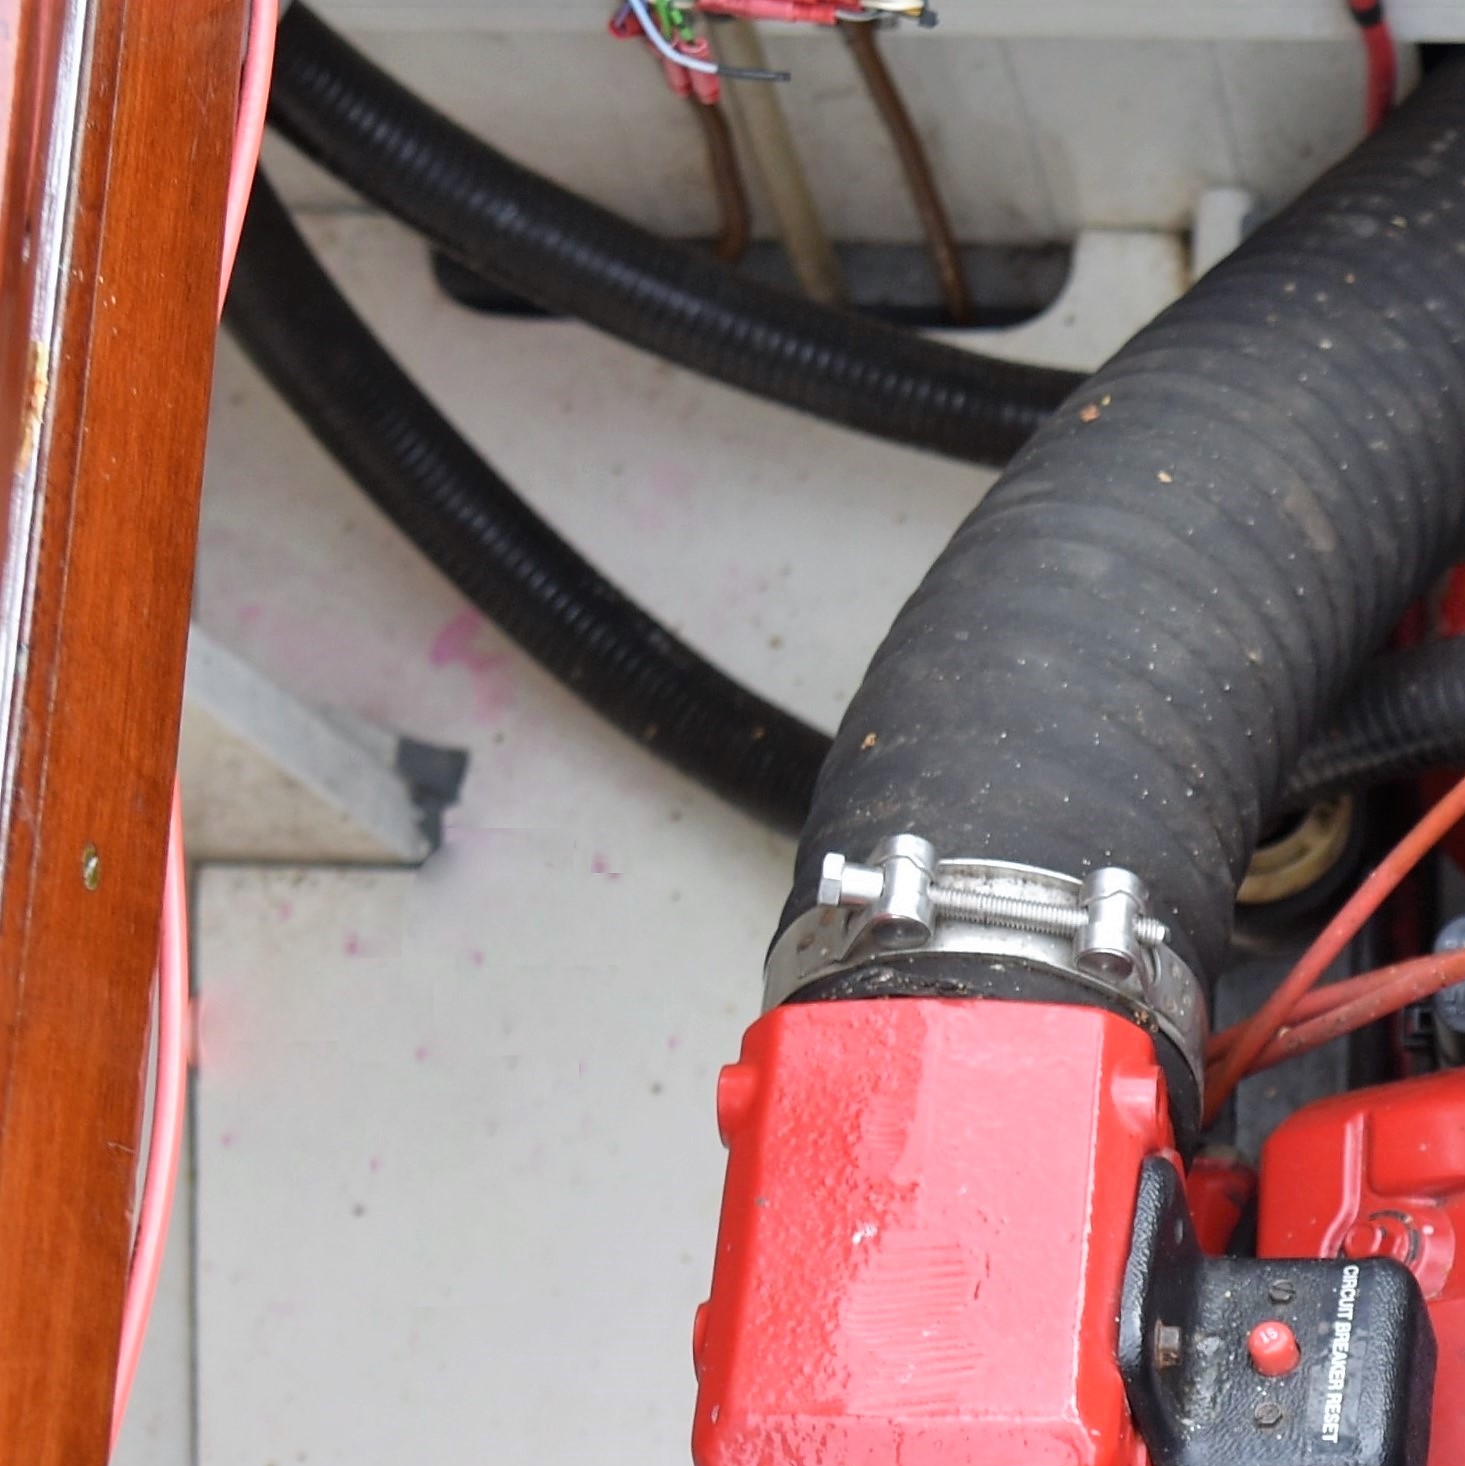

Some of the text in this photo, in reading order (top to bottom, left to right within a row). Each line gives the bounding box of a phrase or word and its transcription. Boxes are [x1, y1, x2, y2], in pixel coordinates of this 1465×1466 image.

[1321, 1265, 1360, 1444] CIRCUIT BREAKER RESET
